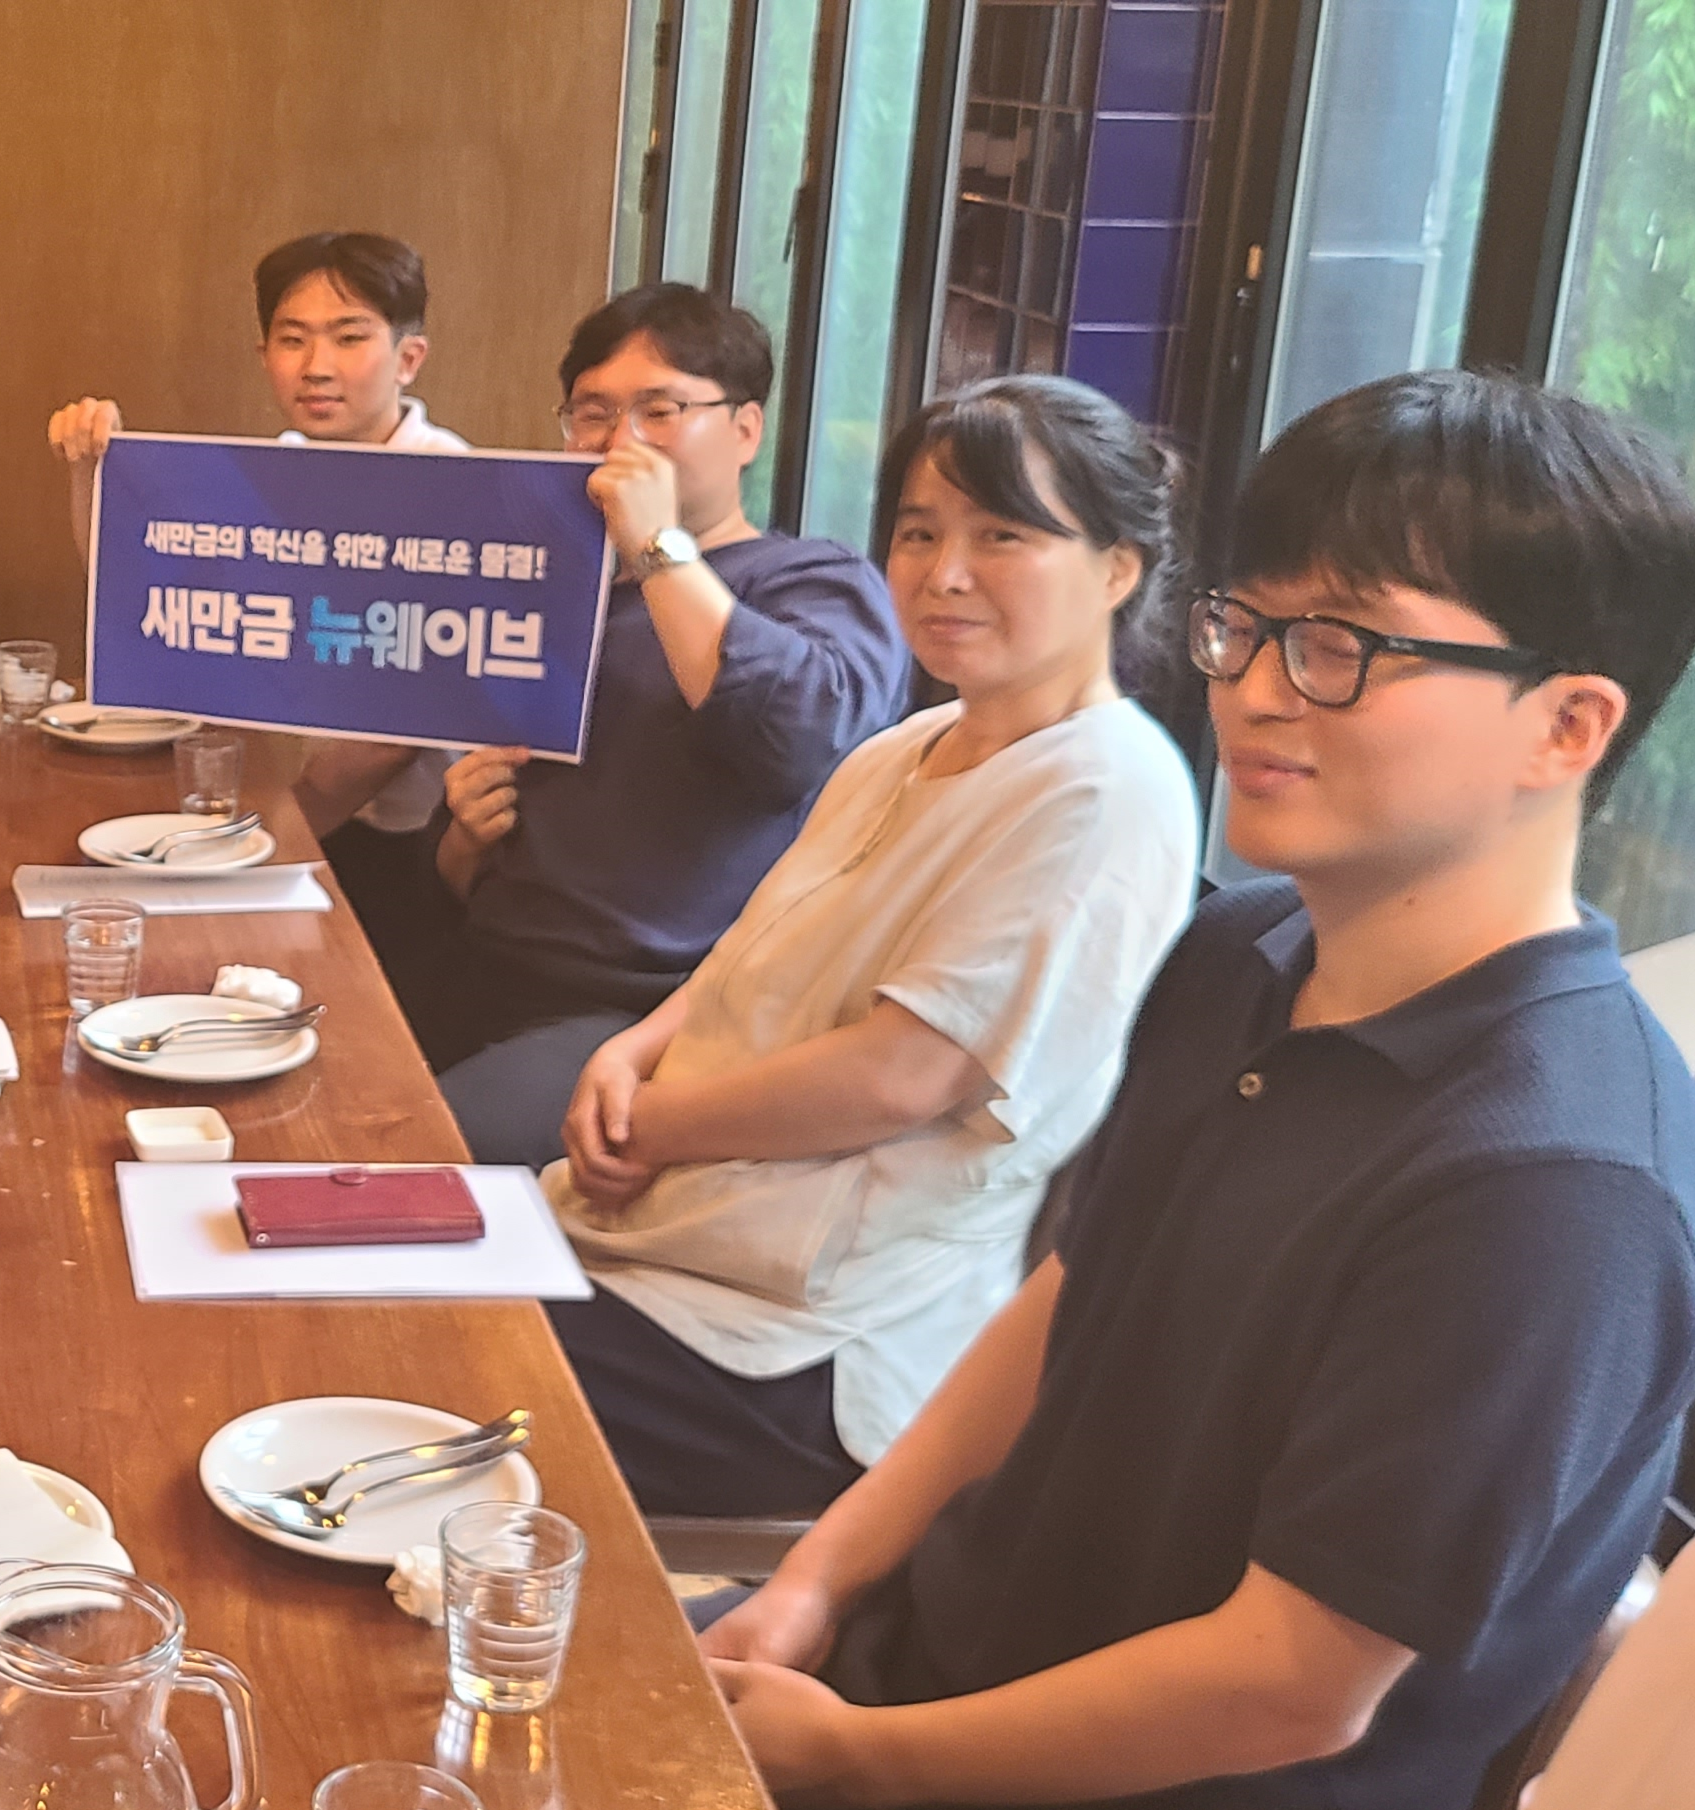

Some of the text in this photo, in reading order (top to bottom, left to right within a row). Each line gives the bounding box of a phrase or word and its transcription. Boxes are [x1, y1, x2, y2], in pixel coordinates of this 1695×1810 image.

[144, 520, 547, 581] 새만금의 혁신을 위한 새로운 물결!
[140, 585, 546, 680] 새만금 뉴웨이브
